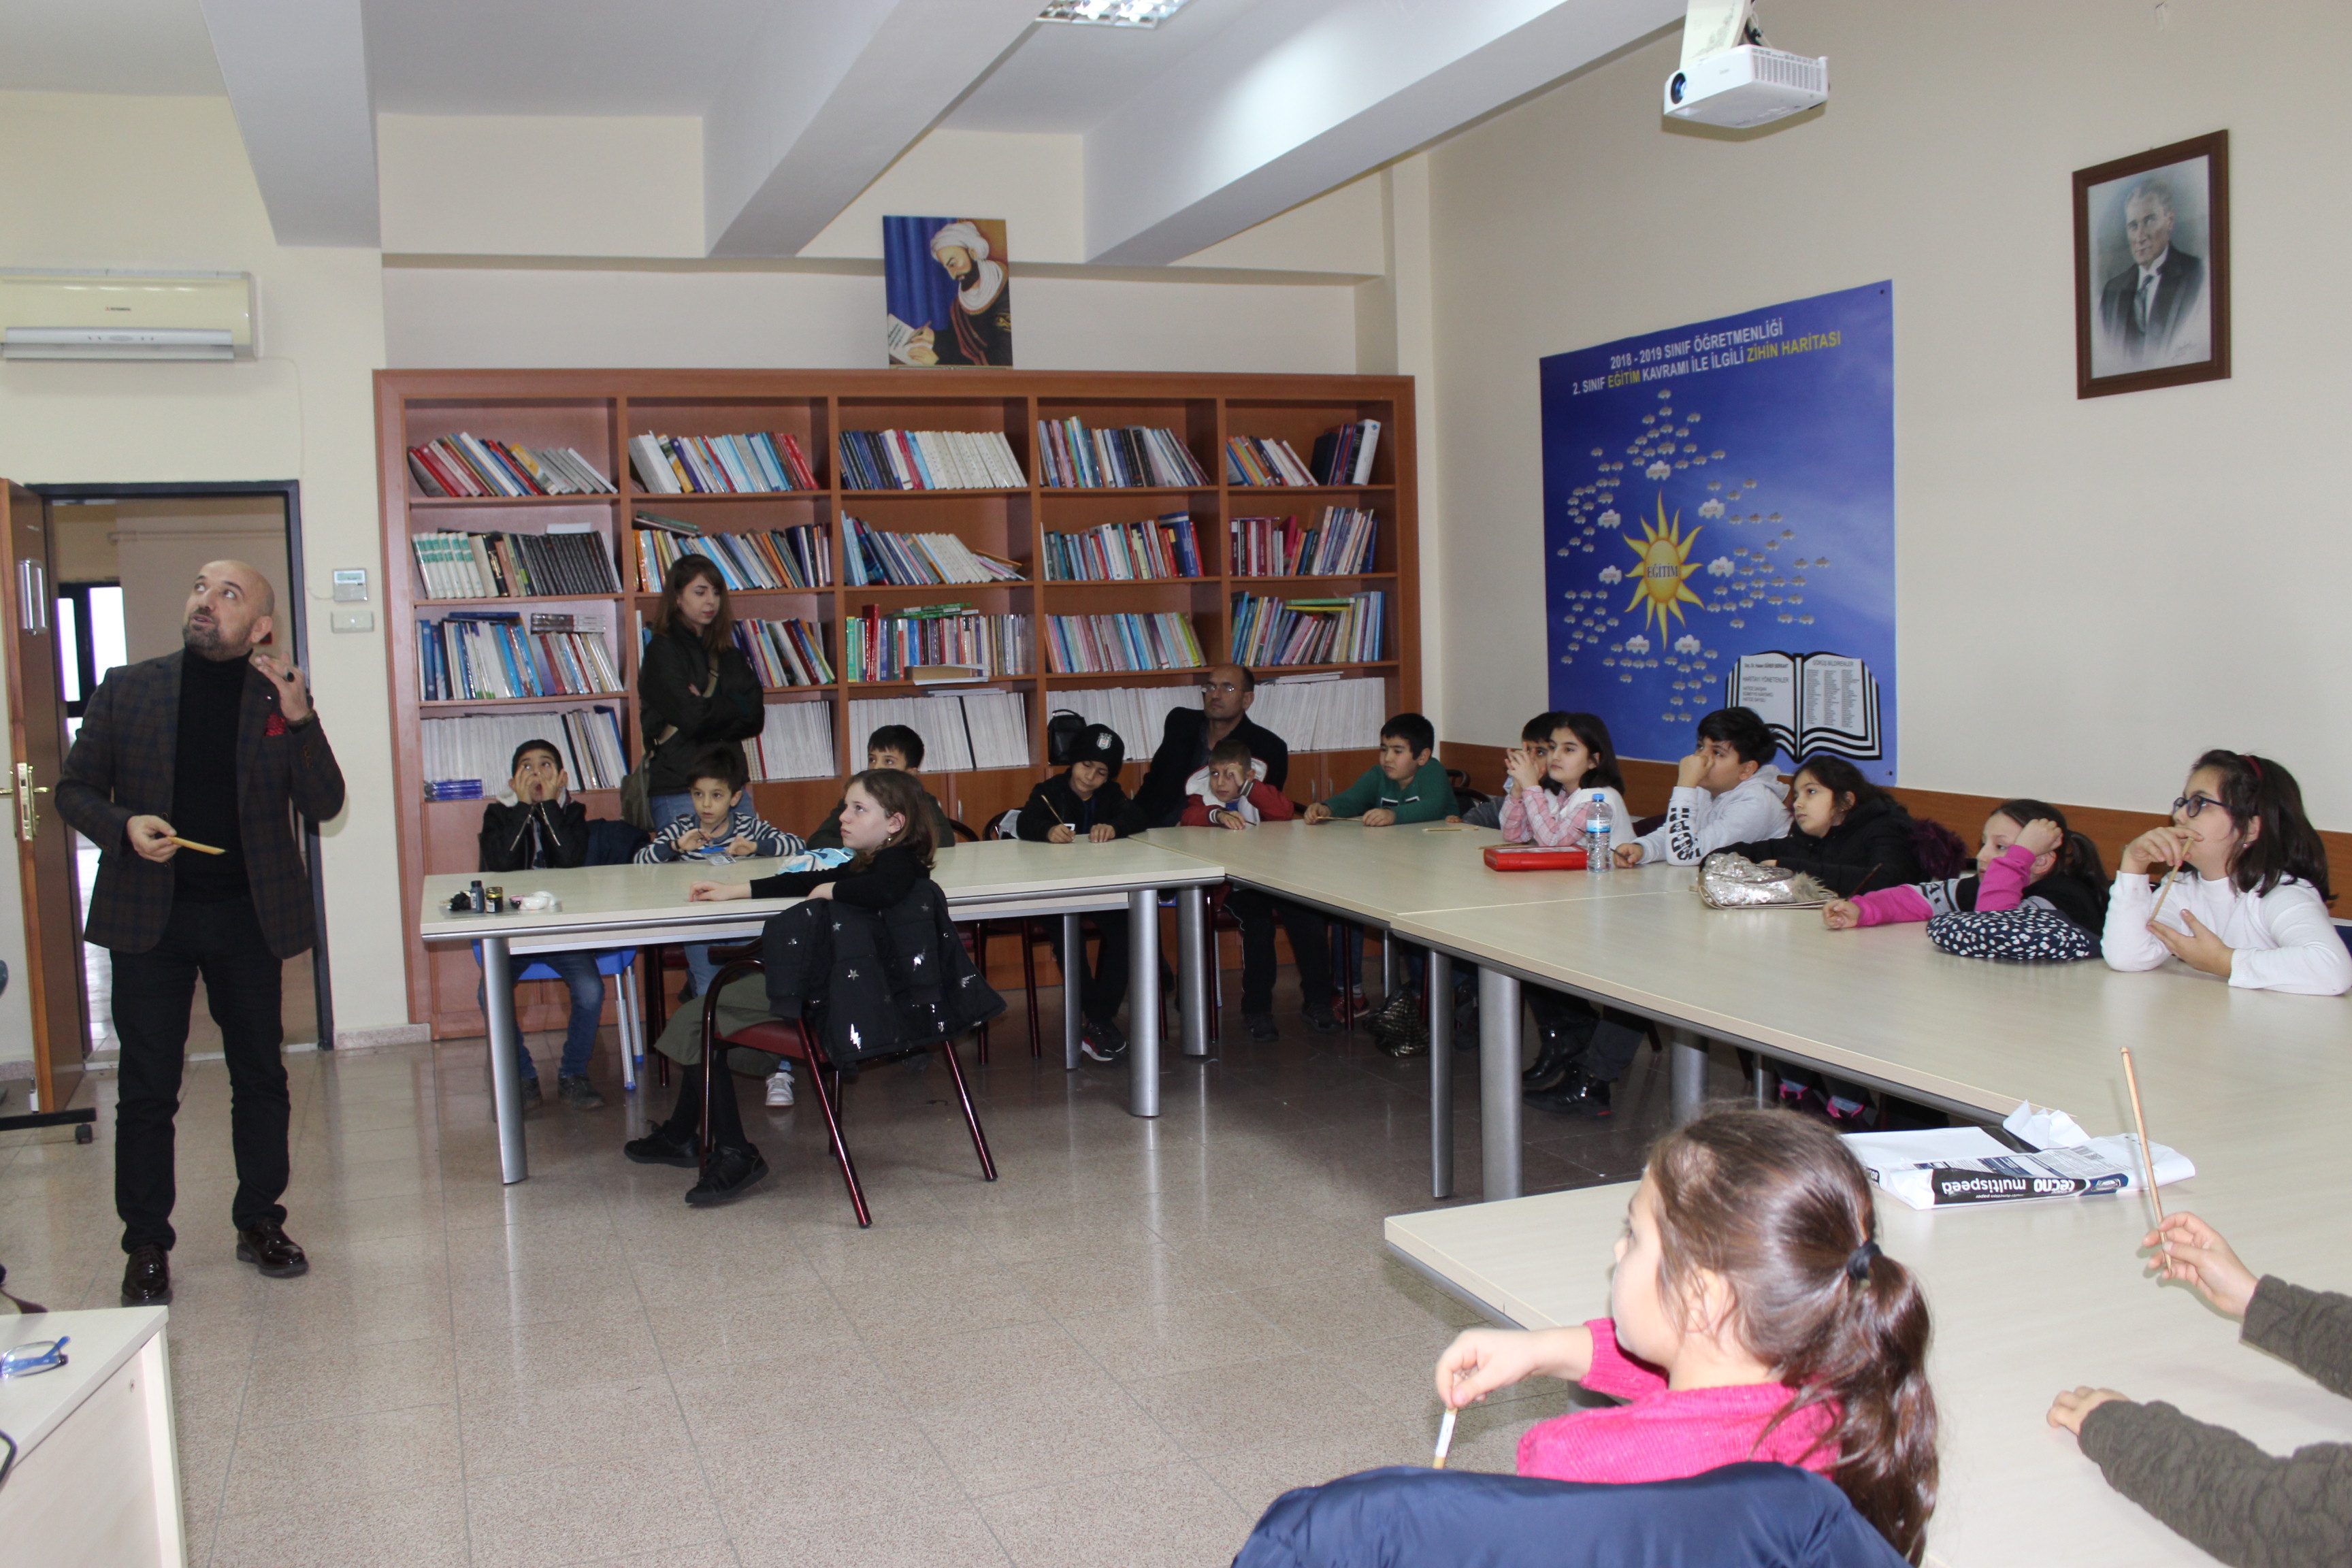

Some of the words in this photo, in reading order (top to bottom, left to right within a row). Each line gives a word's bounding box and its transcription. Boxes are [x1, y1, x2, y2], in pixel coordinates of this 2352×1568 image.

[1610, 353, 1632, 370] 2018
[1639, 346, 1662, 363] 2019
[1664, 340, 1691, 358] SINIF
[1693, 317, 1783, 353] ÖĞRETMENLİĞİ
[1572, 382, 1581, 395] 2.
[1582, 376, 1605, 393] SINIF
[1607, 368, 1641, 388] EĞİTİM
[1642, 360, 1689, 382] KAVRAMI
[1691, 355, 1709, 372] İLE
[1711, 346, 1744, 369] İLGİLİ
[1746, 341, 1778, 362] ZİHİN
[1782, 331, 1841, 355] HARİTASI
[1647, 563, 1679, 578] EĞİTİM
[1941, 1177, 2026, 1194] multispeed
[2034, 1178, 2075, 1194] tecno
